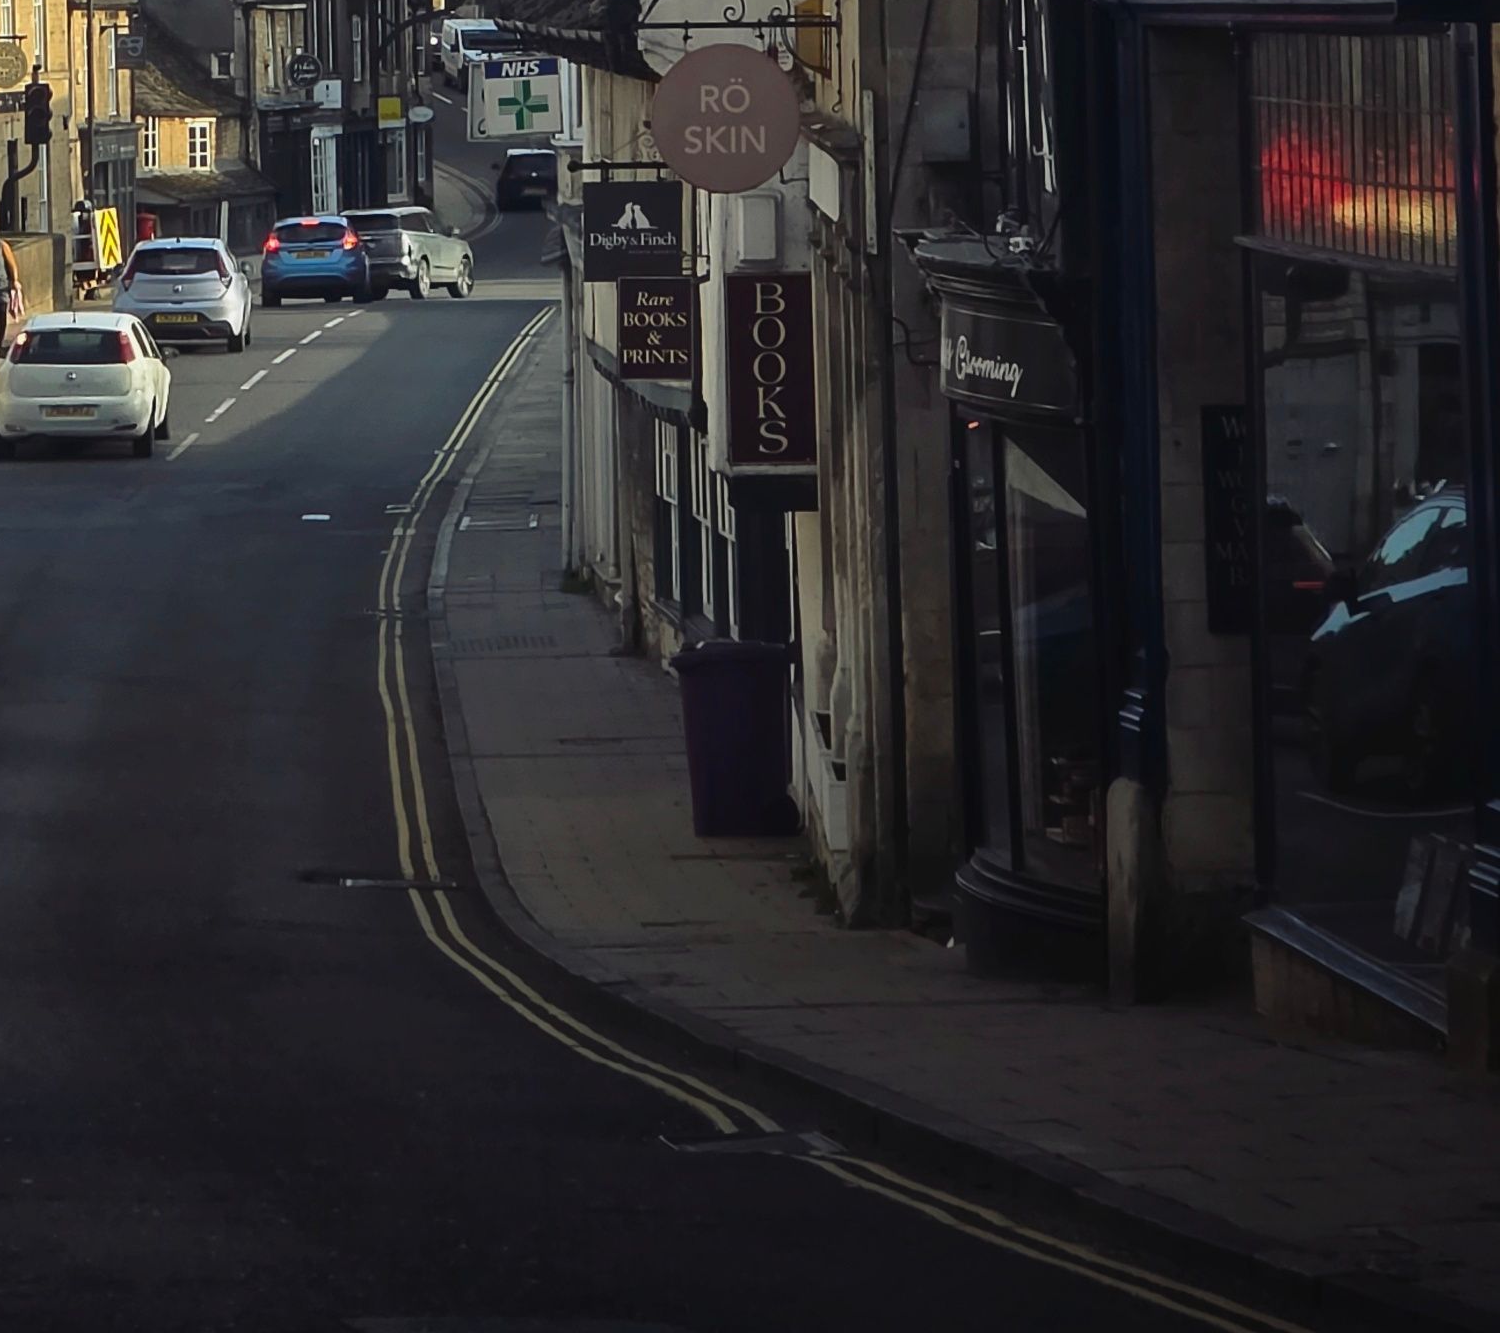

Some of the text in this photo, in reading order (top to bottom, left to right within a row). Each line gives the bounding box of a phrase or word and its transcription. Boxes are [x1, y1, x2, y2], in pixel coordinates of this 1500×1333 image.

[501, 60, 541, 77] NHS
[700, 78, 751, 114] RÖ
[684, 125, 766, 155] SKIN
[589, 232, 628, 250] Digby
[640, 232, 677, 246] Finch
[636, 291, 675, 307] Rare
[623, 311, 688, 327] BOOKS
[647, 330, 663, 346] &
[622, 348, 689, 365] PRINTS
[752, 281, 789, 454] BOOKS
[955, 335, 1024, 398] Grooming
